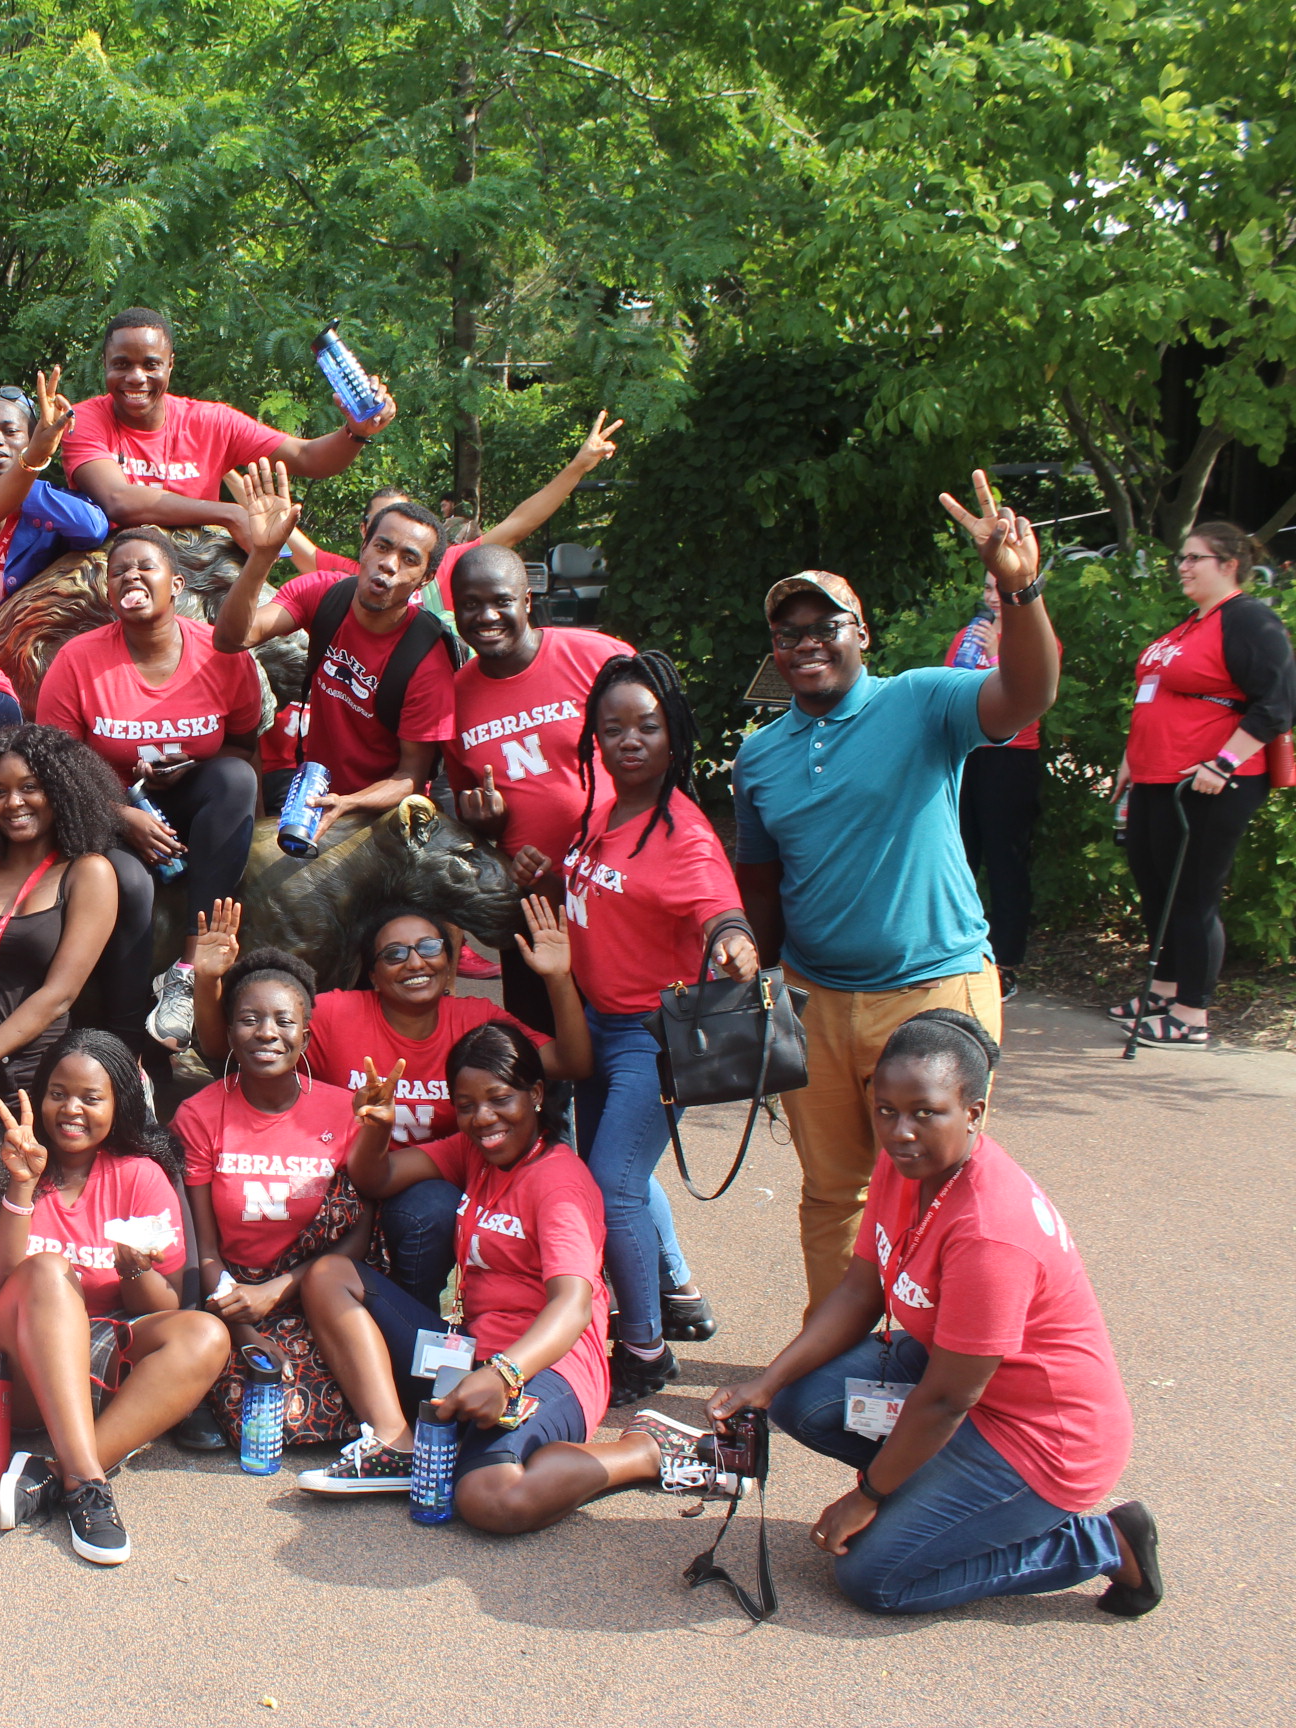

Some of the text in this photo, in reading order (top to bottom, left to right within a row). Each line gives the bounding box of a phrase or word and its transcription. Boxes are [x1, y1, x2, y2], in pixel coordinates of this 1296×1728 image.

[93, 714, 220, 739] NEBRASKA
[461, 700, 581, 750] NEBRASKA
[500, 732, 552, 782] N
[392, 1104, 435, 1143] N
[242, 1181, 291, 1222] N
[25, 1235, 115, 1269] BRASK
[875, 1222, 935, 1309] NEBSKA
[885, 1401, 899, 1414] N
